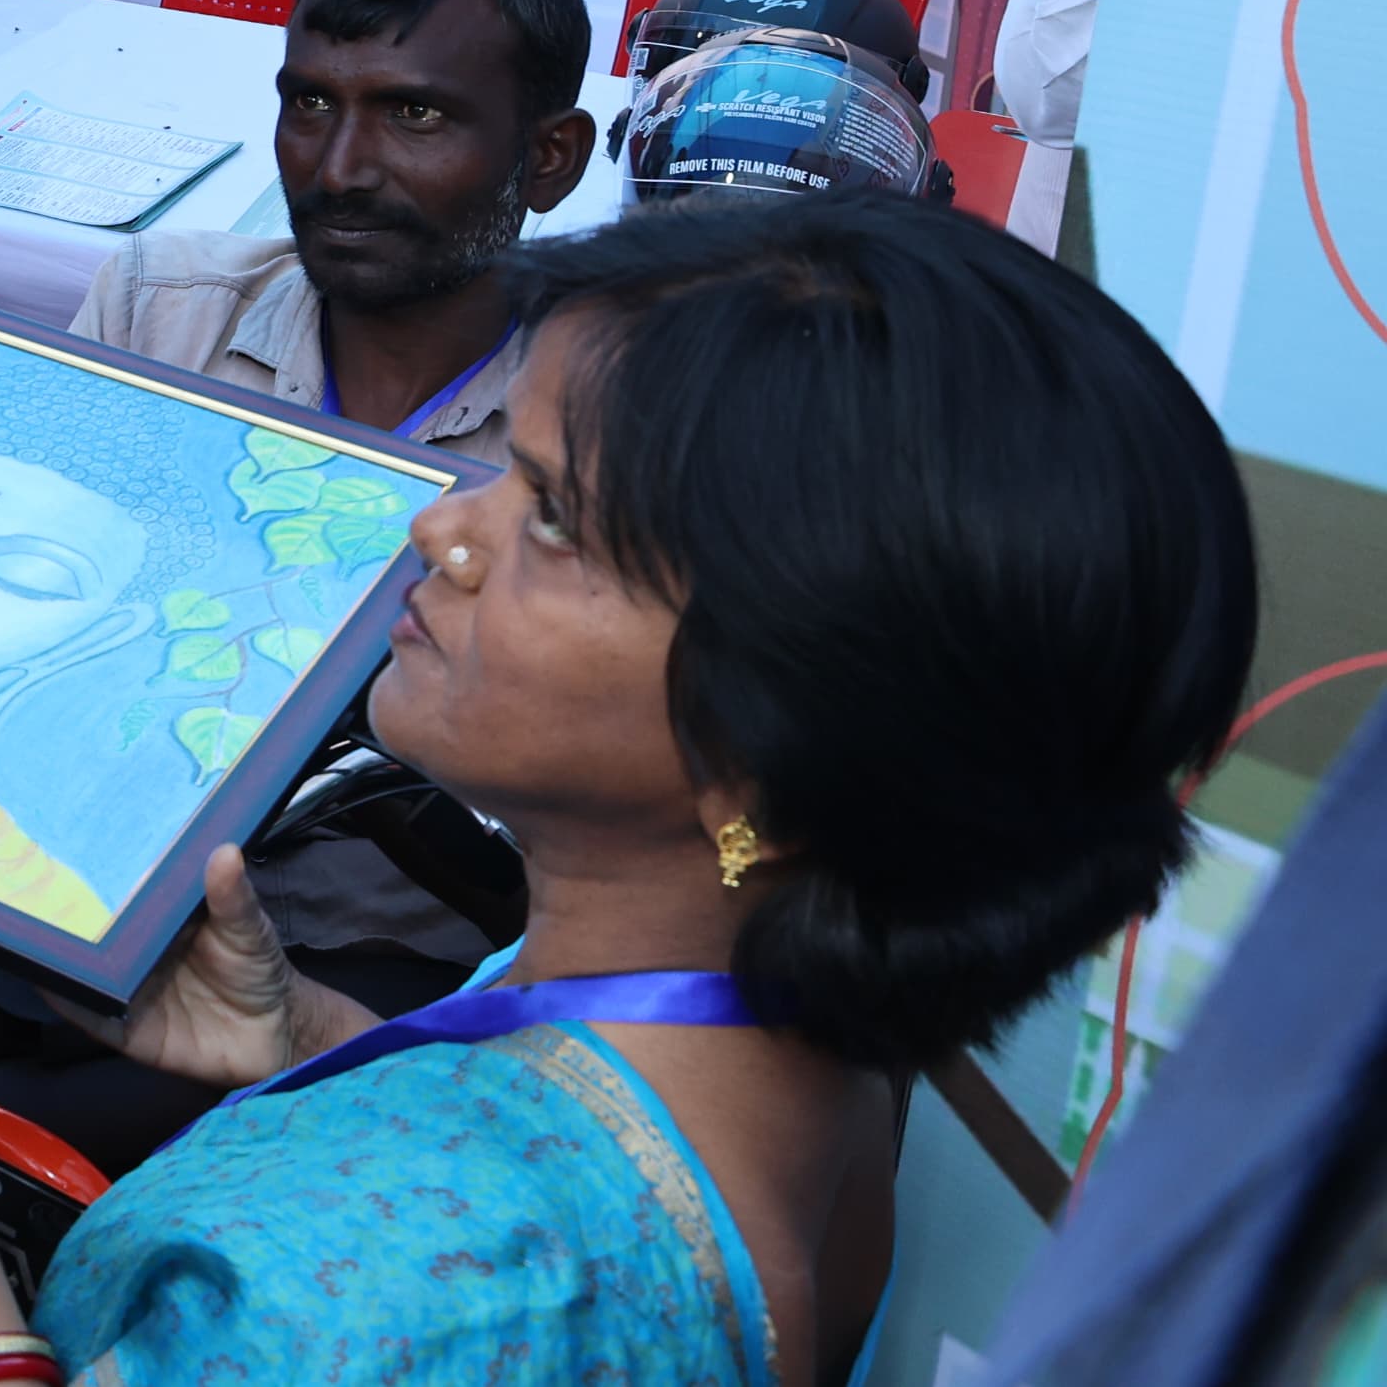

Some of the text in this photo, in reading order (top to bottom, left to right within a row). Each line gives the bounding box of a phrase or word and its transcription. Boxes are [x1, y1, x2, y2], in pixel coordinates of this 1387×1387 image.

[718, 101, 827, 125] SCRATCH RESISTANT VISOR
[669, 159, 708, 175] REMOVE
[710, 158, 735, 172] THIS
[737, 159, 764, 175] FILM
[768, 163, 808, 184] BEFORE
